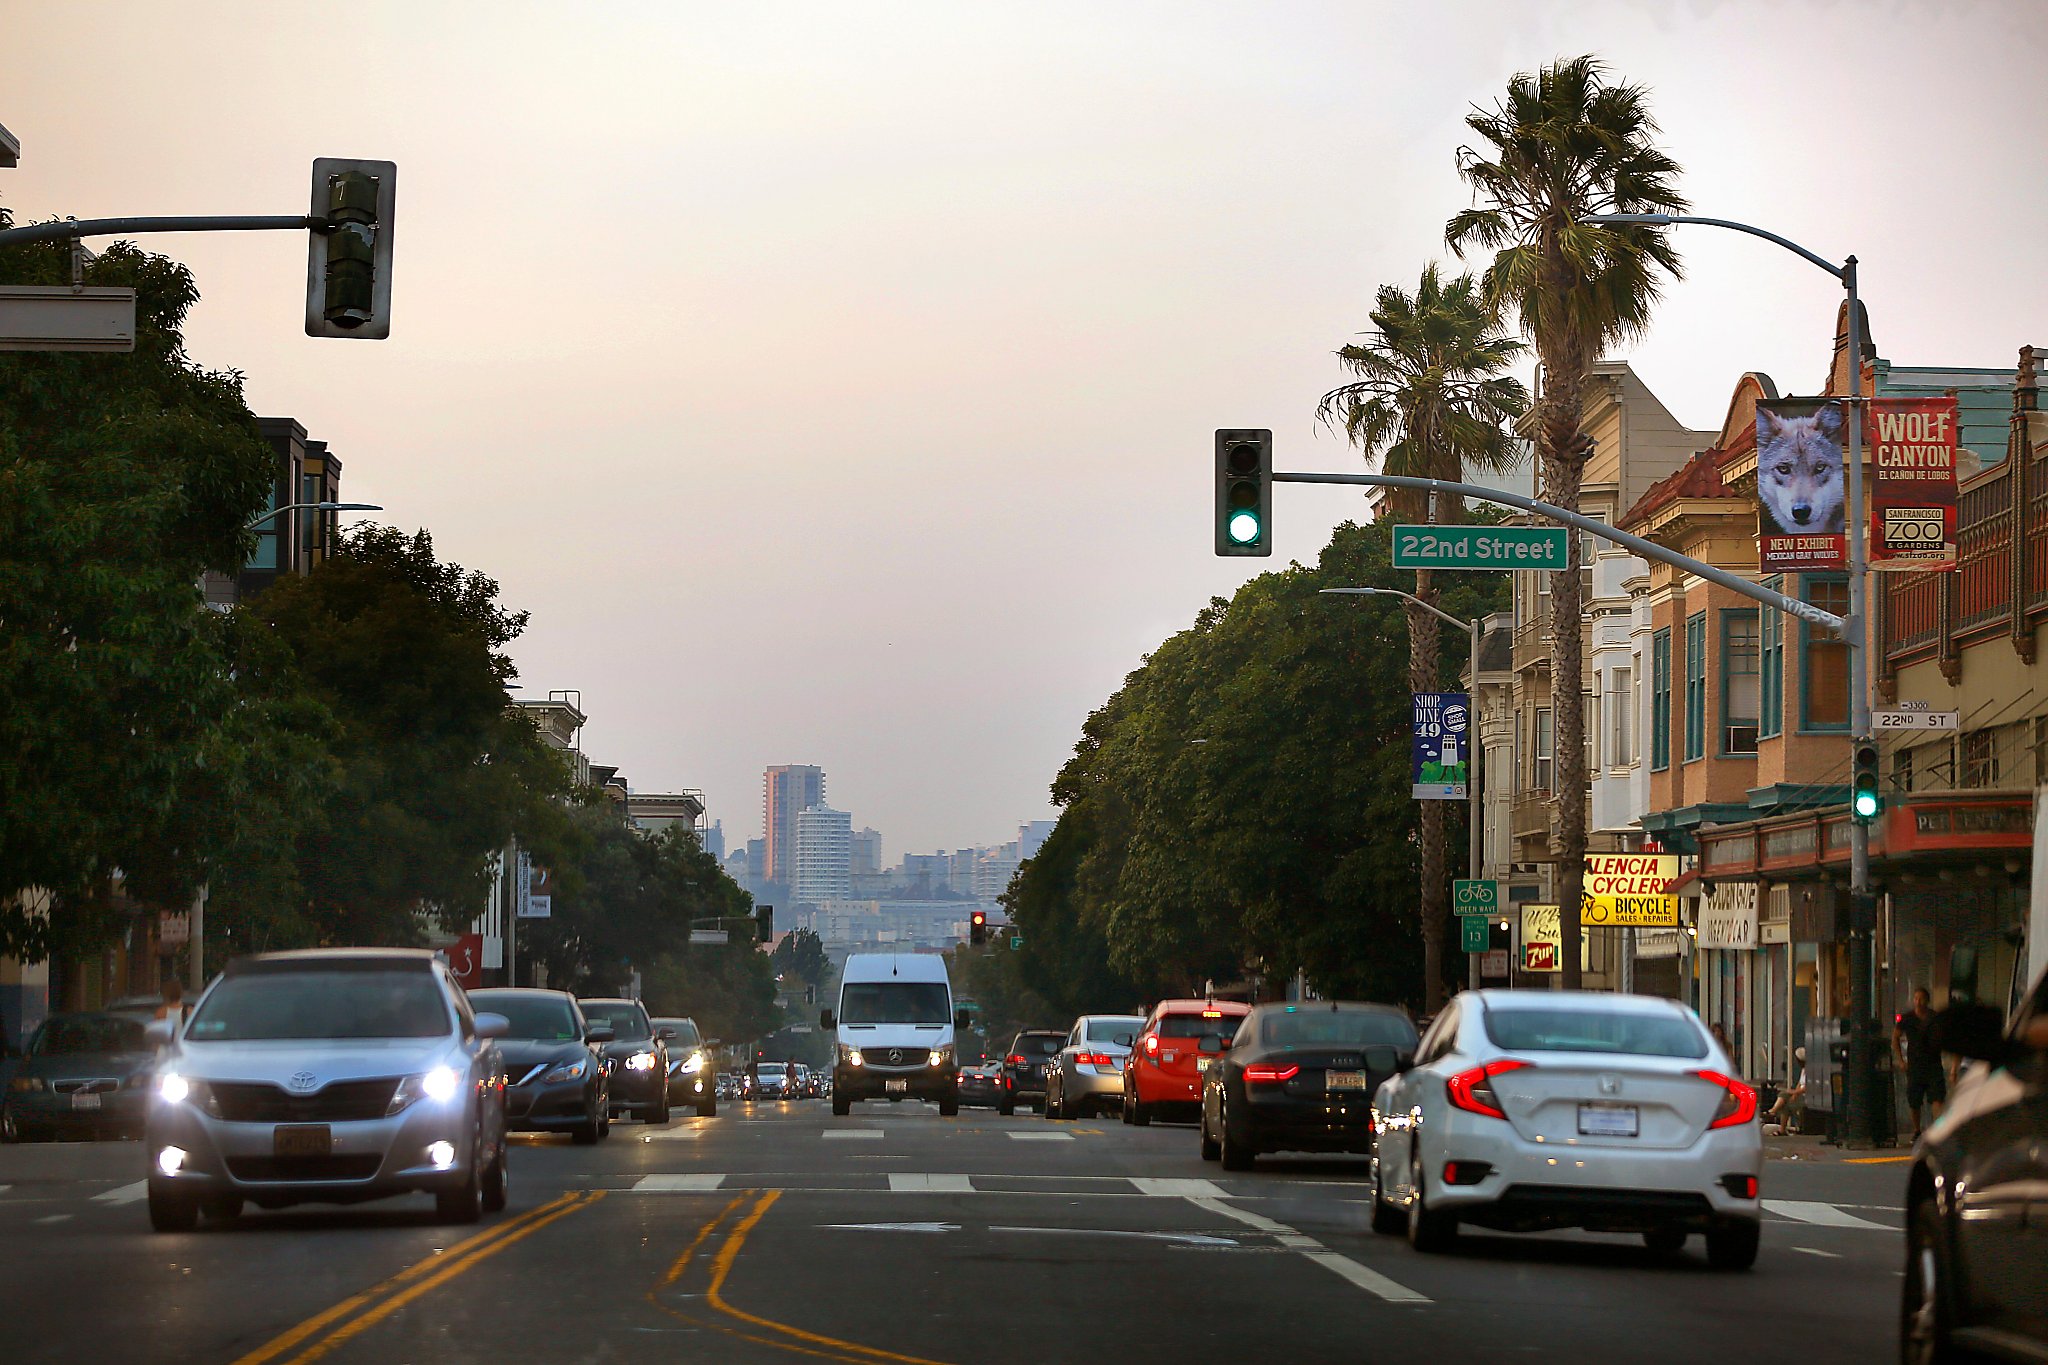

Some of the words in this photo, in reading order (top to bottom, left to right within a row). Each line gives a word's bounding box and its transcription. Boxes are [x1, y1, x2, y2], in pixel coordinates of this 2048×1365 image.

[1876, 412, 1951, 442] WOLF
[1877, 444, 1951, 467] CANYON
[1878, 470, 1888, 480] EL
[1889, 469, 1915, 480] CAÑON
[1916, 470, 1926, 480] DE
[1927, 470, 1950, 480] LOBOS
[1888, 509, 1903, 519] SAN
[1903, 509, 1941, 519] FRANCISCO
[1887, 522, 1942, 540] ZOO
[1401, 535, 1469, 558] 22nd
[1474, 537, 1554, 559] Street
[1770, 538, 1794, 551] NEW
[1796, 537, 1835, 550] EXHIBIT
[1766, 551, 1795, 560] MEXICAN
[1813, 550, 1839, 559] WOLVES
[1415, 694, 1441, 708] SHOP
[1908, 702, 1928, 710] 3300
[1415, 708, 1441, 723] DINE
[1881, 714, 1914, 726] 22ND
[1928, 715, 1947, 727] ST
[1415, 722, 1441, 738] 49
[1585, 857, 1659, 875] ALENCIA
[1592, 876, 1674, 895] CYCLERY
[1455, 905, 1477, 914] GREEN
[1478, 905, 1497, 913] WAVE
[1615, 898, 1671, 915] BICYCLE
[1615, 915, 1638, 923] SALES
[1643, 915, 1673, 923] REPAIRS
[1469, 931, 1482, 942] 13
